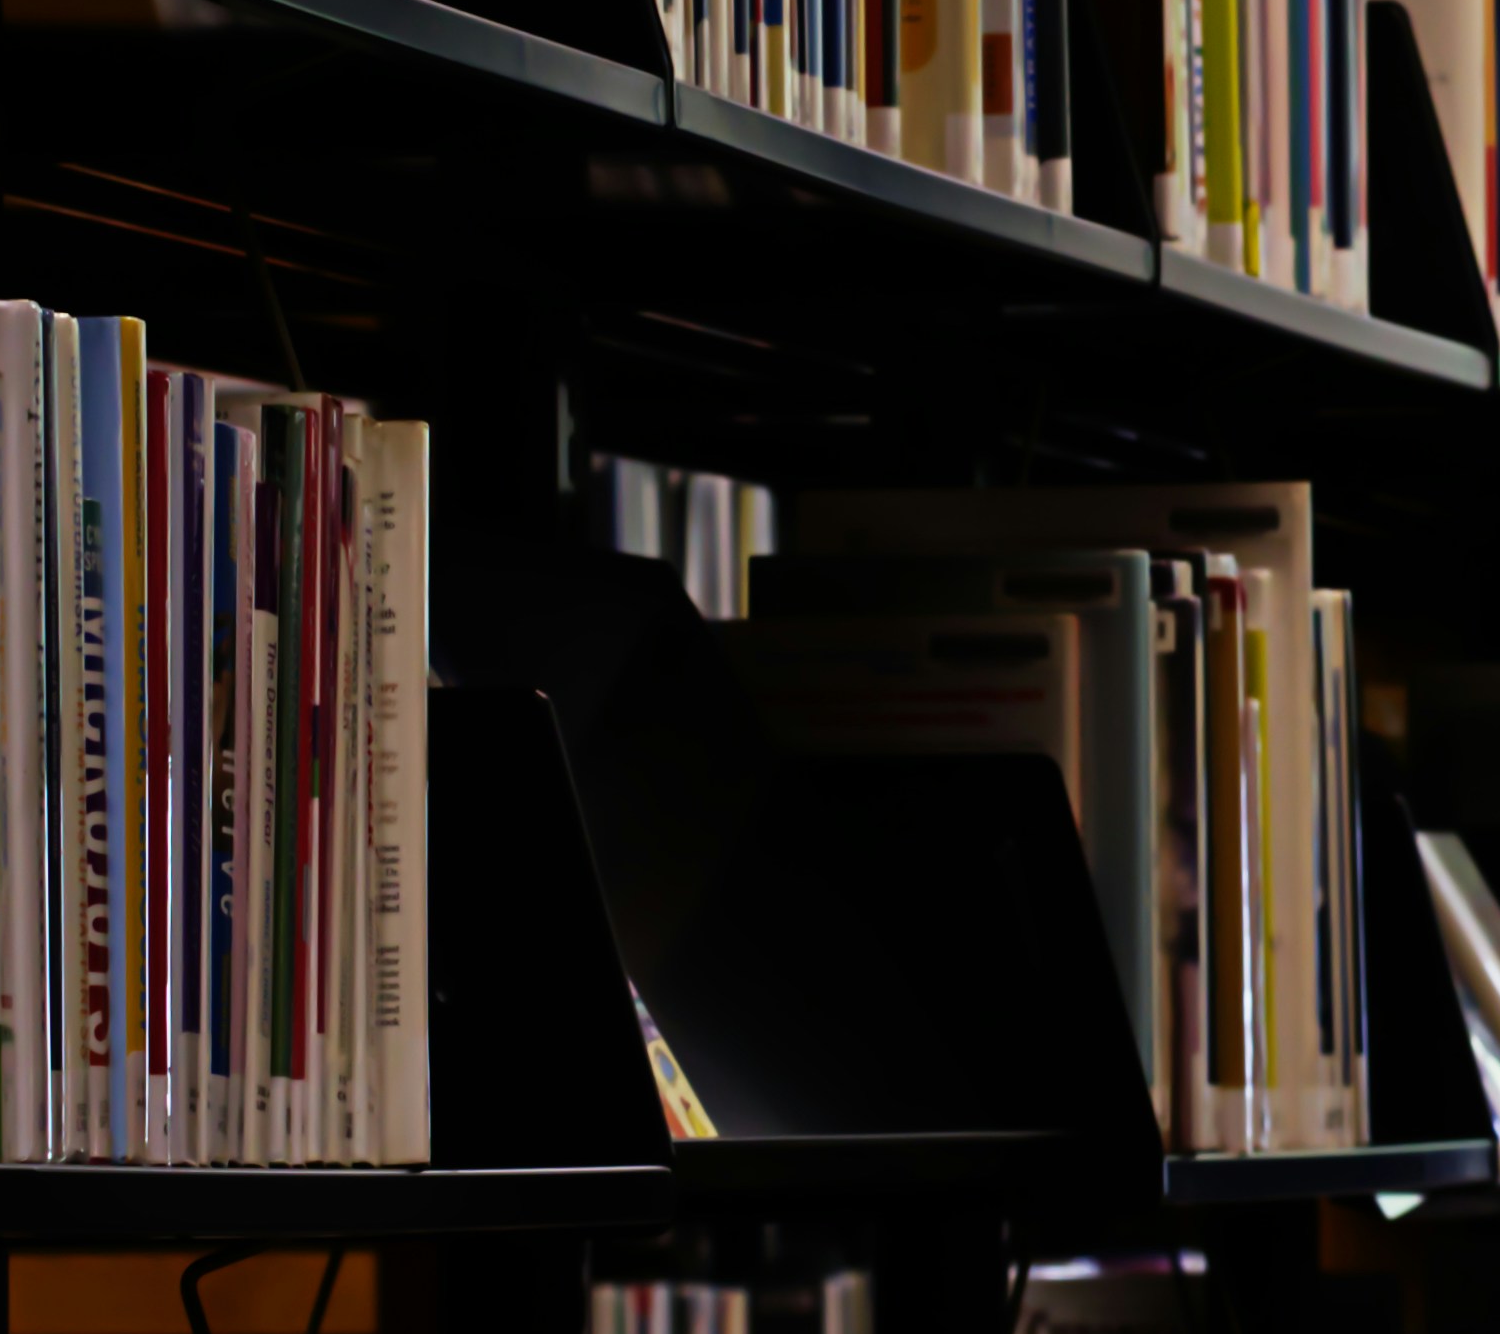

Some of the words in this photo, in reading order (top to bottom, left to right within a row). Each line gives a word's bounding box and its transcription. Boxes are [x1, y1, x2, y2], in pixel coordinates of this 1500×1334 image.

[267, 641, 276, 680] The
[267, 687, 275, 758] Dance
[265, 767, 274, 794] of
[265, 798, 273, 848] Fear
